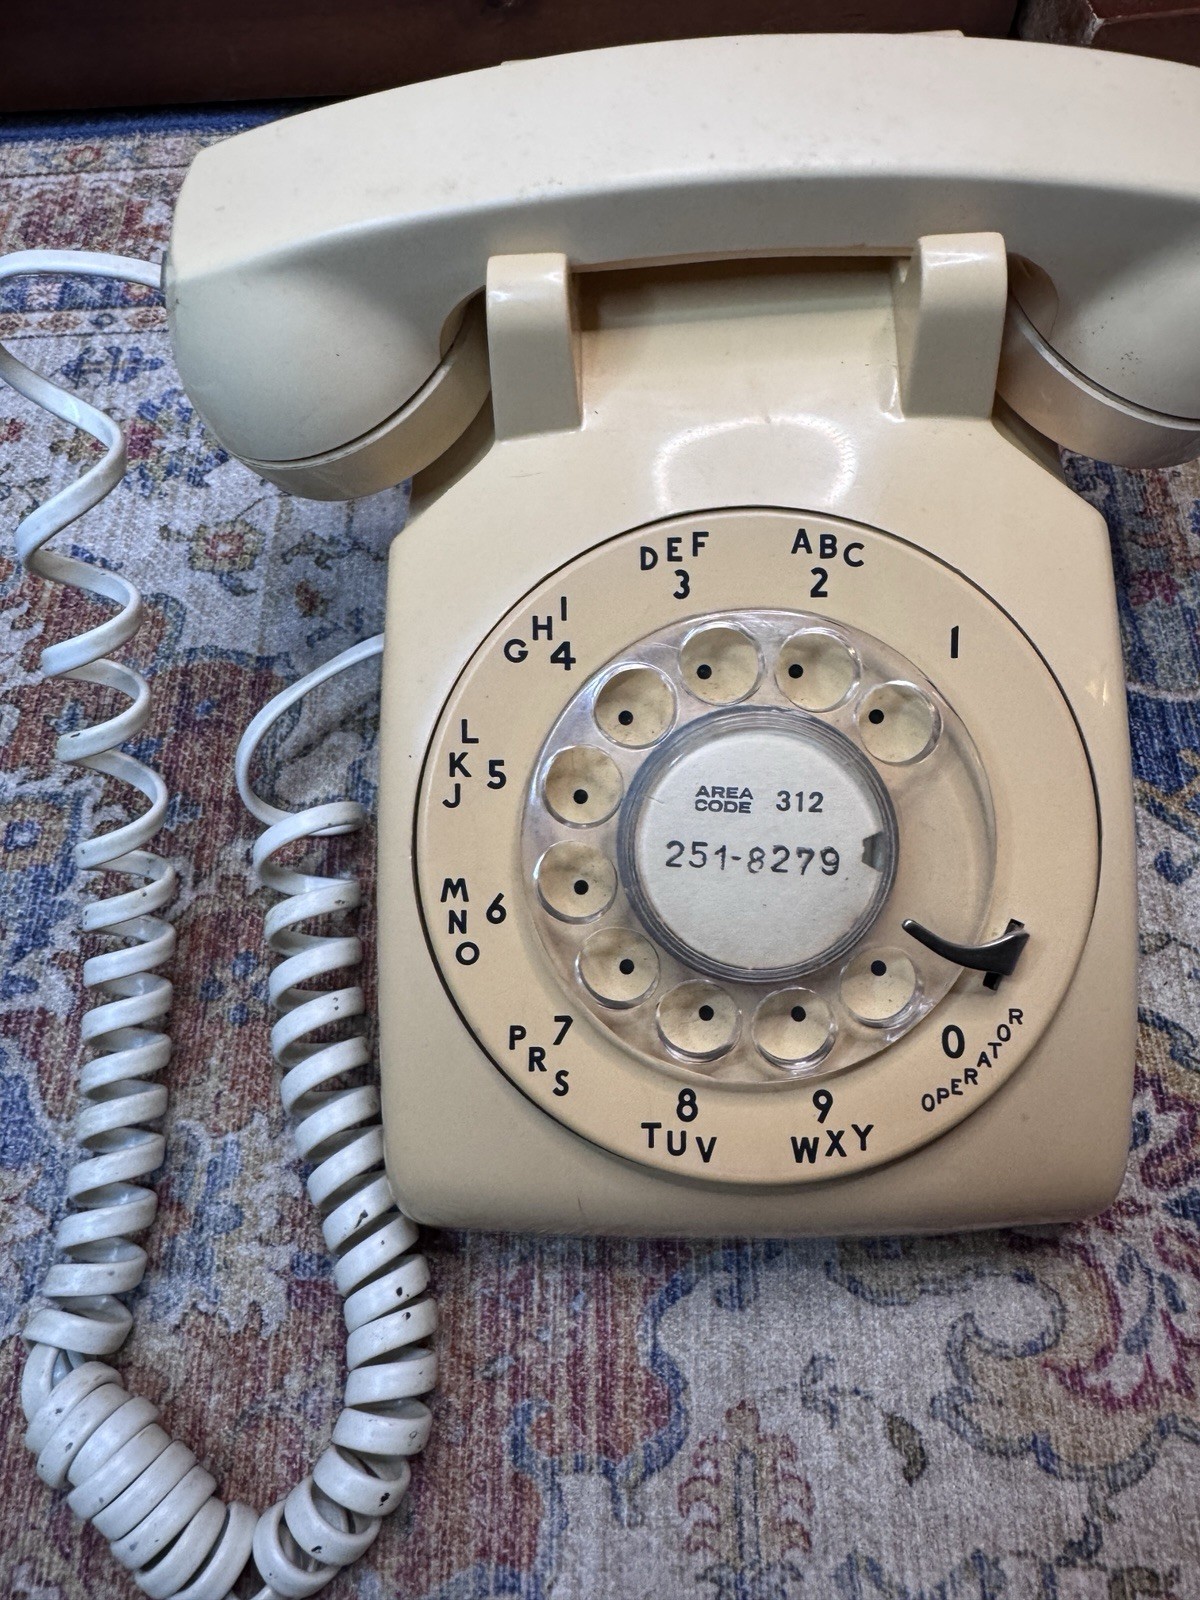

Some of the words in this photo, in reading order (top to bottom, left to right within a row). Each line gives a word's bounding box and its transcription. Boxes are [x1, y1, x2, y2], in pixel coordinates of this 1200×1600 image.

[639, 531, 709, 571] DEF
[791, 528, 865, 568] ABC
[672, 569, 691, 600] 3
[810, 567, 829, 598] 2
[503, 596, 568, 664] GHI
[950, 625, 960, 659] 1
[550, 641, 577, 671] 4
[486, 759, 507, 790] 5
[694, 799, 752, 814] CODE
[695, 785, 754, 800] AREA
[775, 790, 824, 813] 312
[665, 840, 840, 876] 251-8279
[440, 877, 481, 966] MNO
[486, 892, 507, 925] 6
[552, 1015, 574, 1046] 7
[941, 1024, 966, 1060] 0
[508, 1025, 570, 1097] PRS
[921, 1008, 1024, 1113] OPERATOR
[675, 1087, 699, 1123] 8
[812, 1088, 834, 1125] 9
[640, 1121, 718, 1164] TUV
[790, 1123, 875, 1164] WXY
